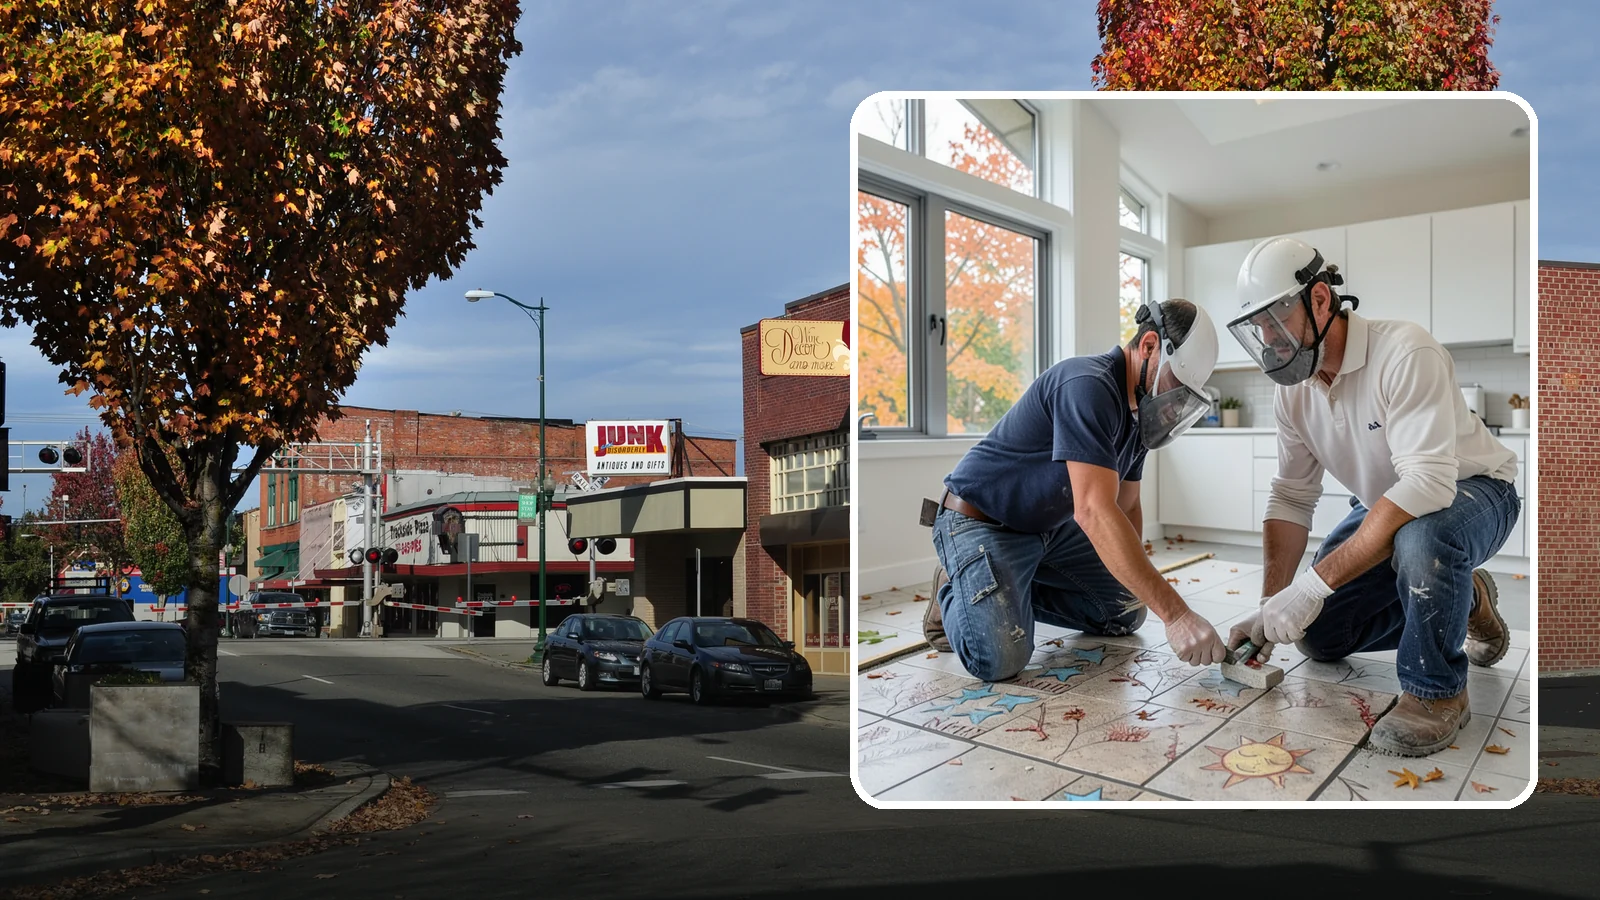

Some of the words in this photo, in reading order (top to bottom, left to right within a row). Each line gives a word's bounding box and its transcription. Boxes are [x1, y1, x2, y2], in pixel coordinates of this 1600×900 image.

[765, 327, 831, 366] Decor
[595, 425, 665, 457] JUNK
[607, 446, 646, 454] DISORDERLY
[597, 461, 628, 470] ANTIQUES
[631, 461, 644, 470] AND
[647, 460, 665, 470] GIFTS
[390, 521, 413, 540] Trackside
[415, 519, 429, 535] Pizza
